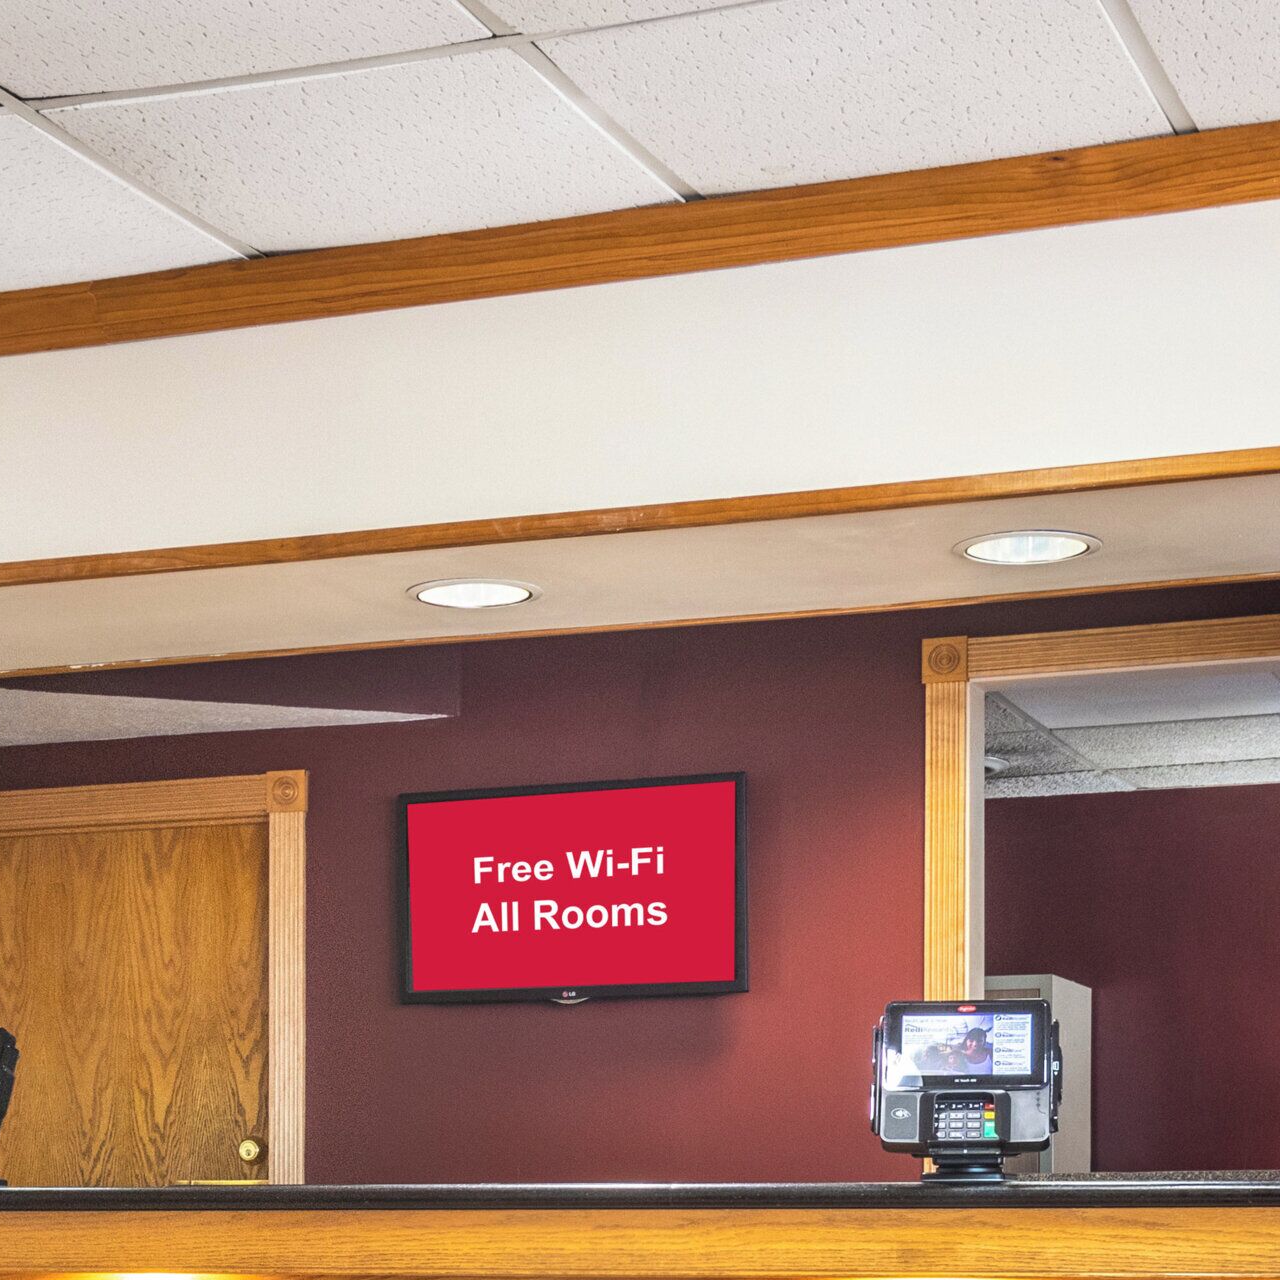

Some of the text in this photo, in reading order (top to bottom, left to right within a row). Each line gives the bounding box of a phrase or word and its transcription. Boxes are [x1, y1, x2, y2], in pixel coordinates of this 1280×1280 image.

[473, 846, 664, 884] Free Wi-Fi
[471, 900, 668, 934] All Rooms
